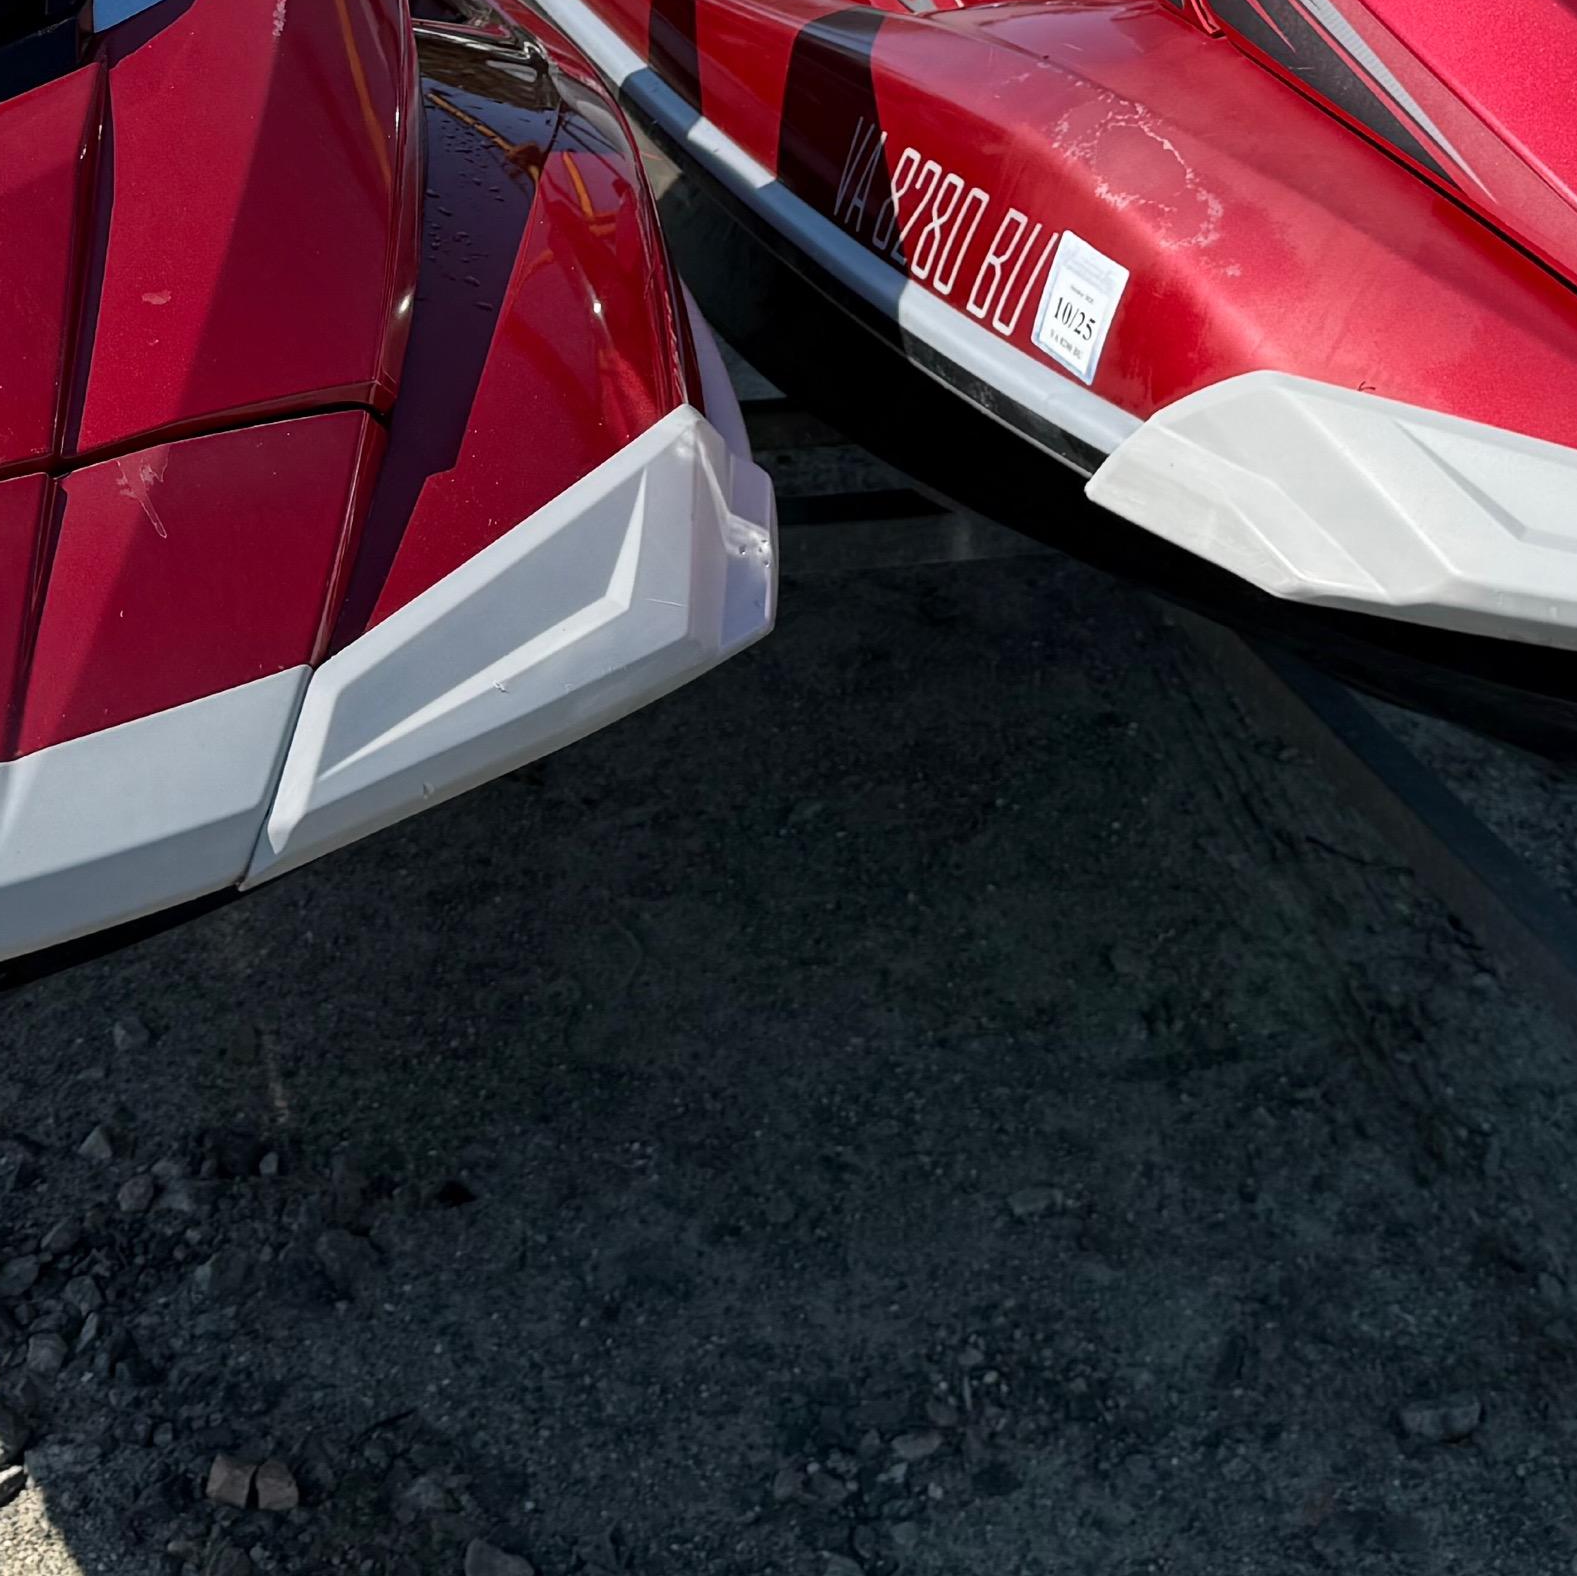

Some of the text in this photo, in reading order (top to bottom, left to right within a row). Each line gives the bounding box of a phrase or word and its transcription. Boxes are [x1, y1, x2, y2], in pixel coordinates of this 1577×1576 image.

[834, 116, 888, 233] VA
[966, 207, 1059, 336] BU
[1053, 296, 1097, 341] 10/25
